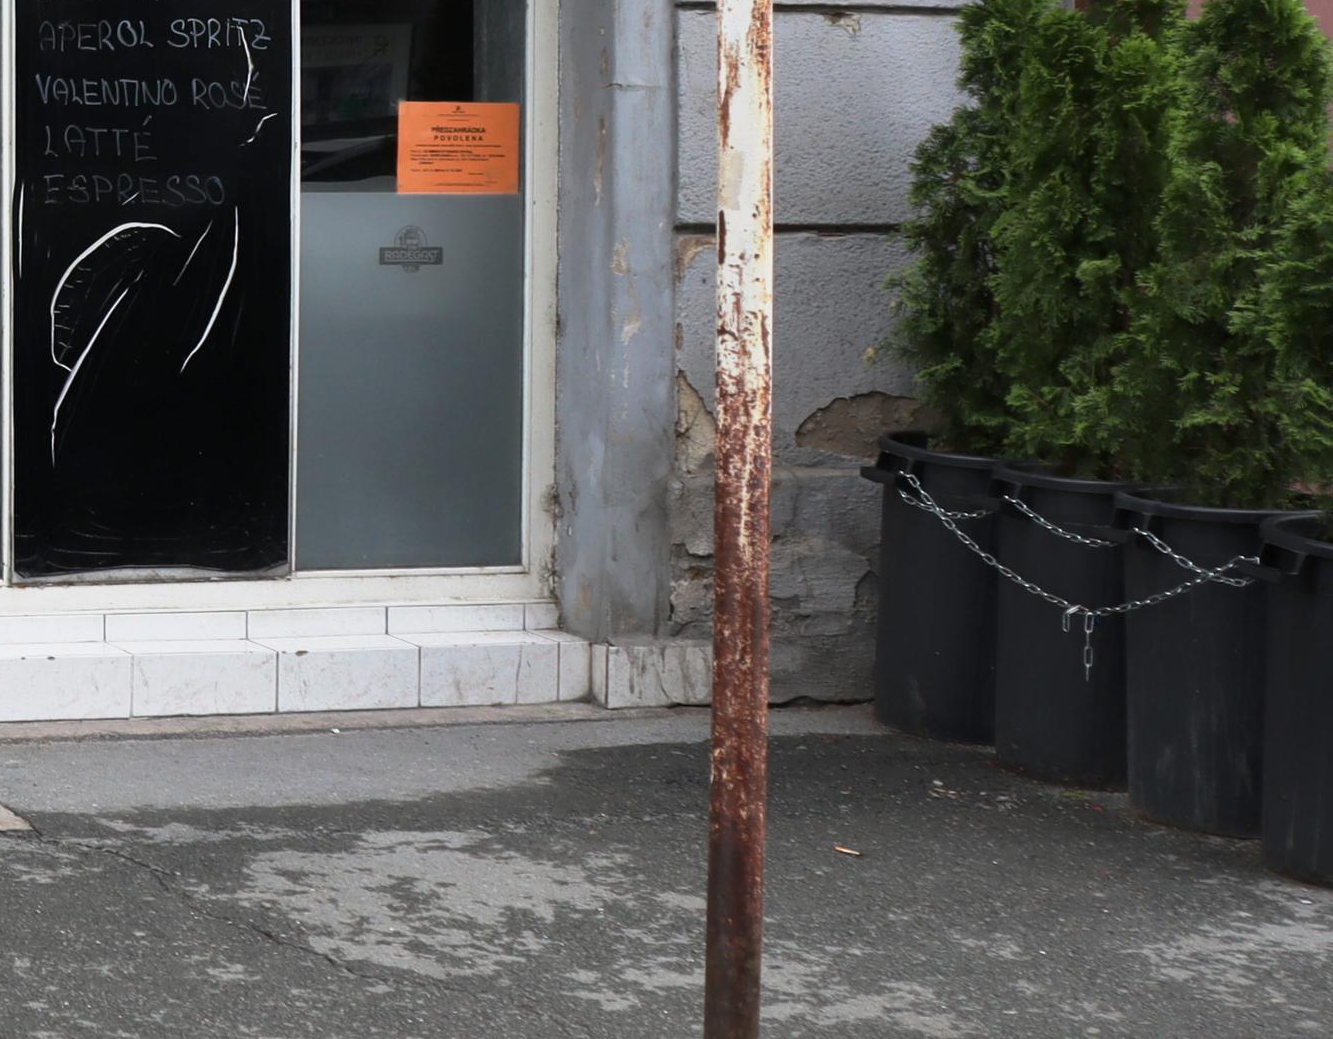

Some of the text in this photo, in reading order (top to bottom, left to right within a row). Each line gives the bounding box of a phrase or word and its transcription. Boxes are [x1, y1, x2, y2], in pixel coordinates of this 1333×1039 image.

[38, 17, 272, 52] APEROL SPRITZ
[35, 73, 179, 107] VALENTINO
[44, 114, 159, 162] LATTÉ
[43, 173, 226, 207] ESPRESSO
[384, 249, 440, 263] RADEGAST
